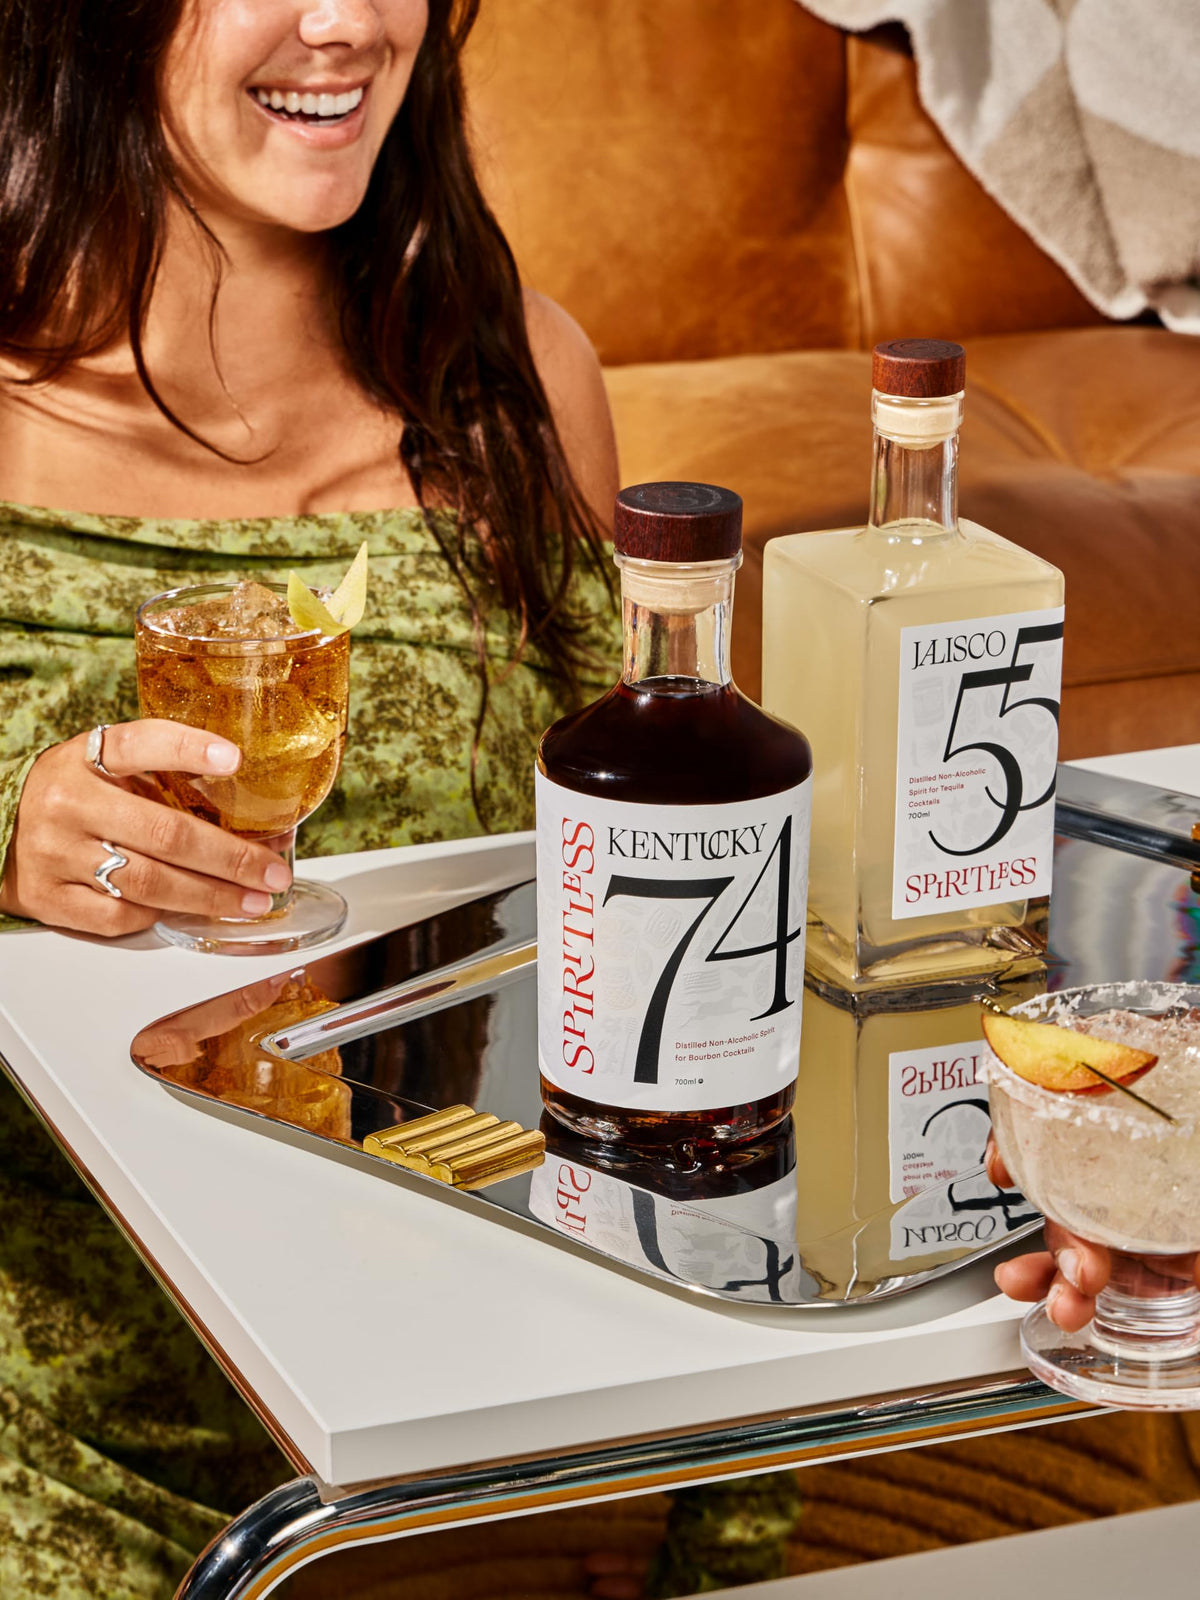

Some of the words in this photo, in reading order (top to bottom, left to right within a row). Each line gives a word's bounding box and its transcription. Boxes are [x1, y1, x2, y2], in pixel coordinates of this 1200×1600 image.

[912, 630, 1006, 670] JALISCO
[928, 621, 1064, 857] 55
[909, 774, 937, 784] Distilled
[938, 768, 987, 780] Non-Alcoholic
[908, 788, 927, 797] Spirit
[928, 786, 939, 794] for
[940, 783, 965, 793] Tequila
[908, 798, 940, 808] Cocktails
[908, 811, 931, 820] 700ml
[607, 822, 768, 862] KENTUCKY
[905, 857, 1037, 904] SPIRITLESS
[561, 817, 595, 1075] SPIRITLESS
[602, 814, 801, 1085] 74
[675, 1041, 707, 1049] Distilled
[708, 1032, 759, 1047] Non-Alcoholic
[759, 1026, 775, 1037] Spirit
[675, 1054, 687, 1062] for
[688, 1052, 721, 1061] Bourbon
[722, 1046, 755, 1058] Cocktails
[675, 1078, 697, 1086] 700ml
